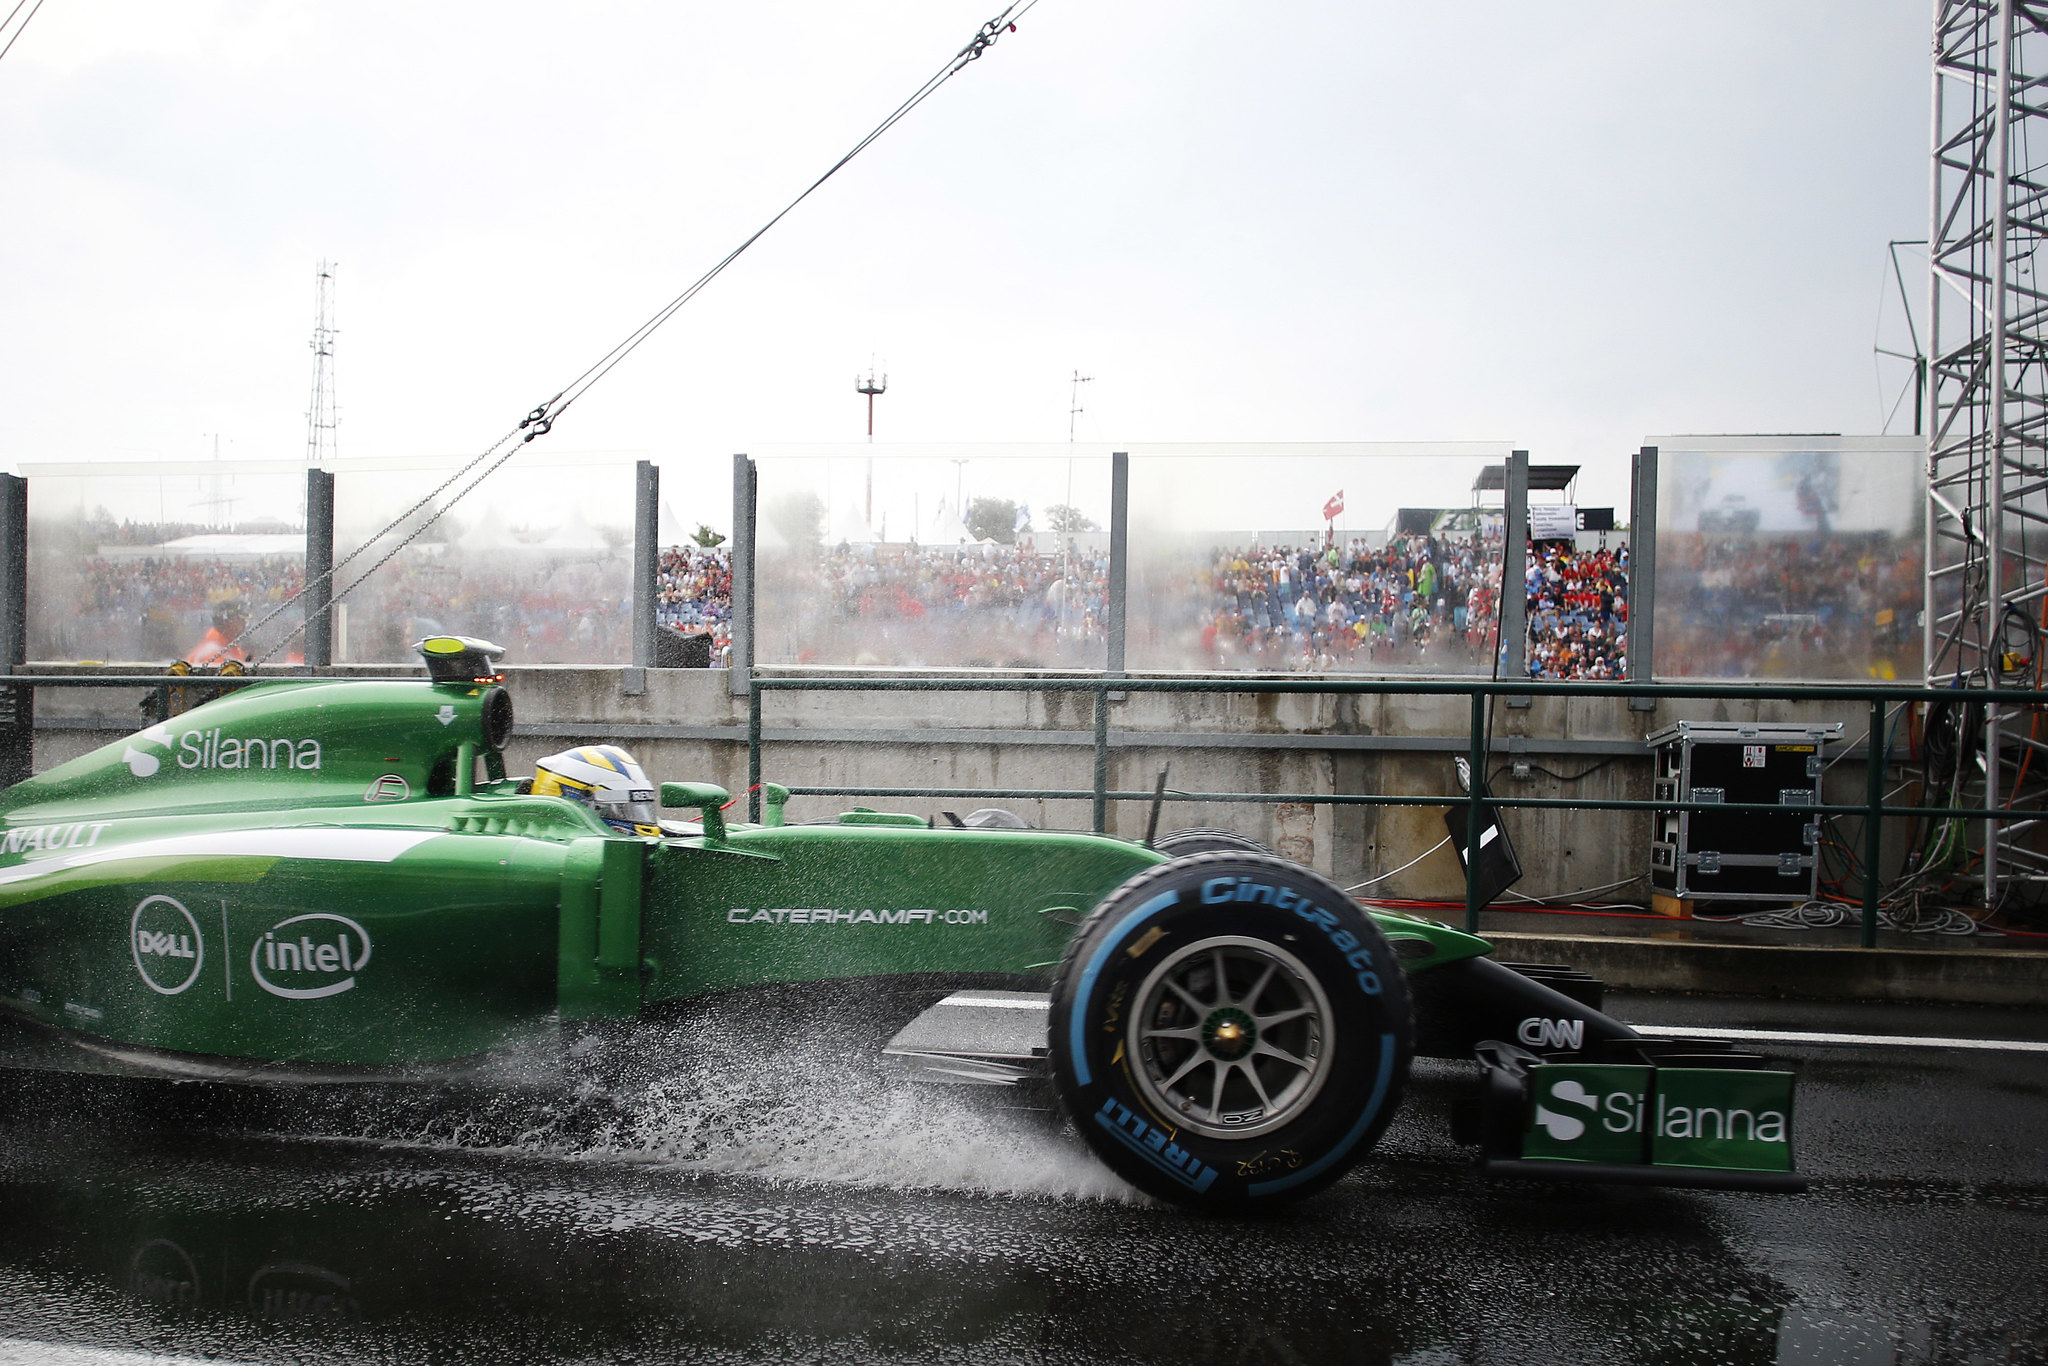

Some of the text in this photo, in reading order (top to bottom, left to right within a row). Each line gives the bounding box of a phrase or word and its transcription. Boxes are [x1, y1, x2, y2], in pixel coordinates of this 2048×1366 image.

[177, 728, 320, 769] Silanna
[0, 823, 112, 854] NAULT
[138, 930, 194, 958] DELL
[265, 932, 352, 972] intel
[1517, 1017, 1584, 1050] CNN
[1094, 1096, 1219, 1194] PIRELLI
